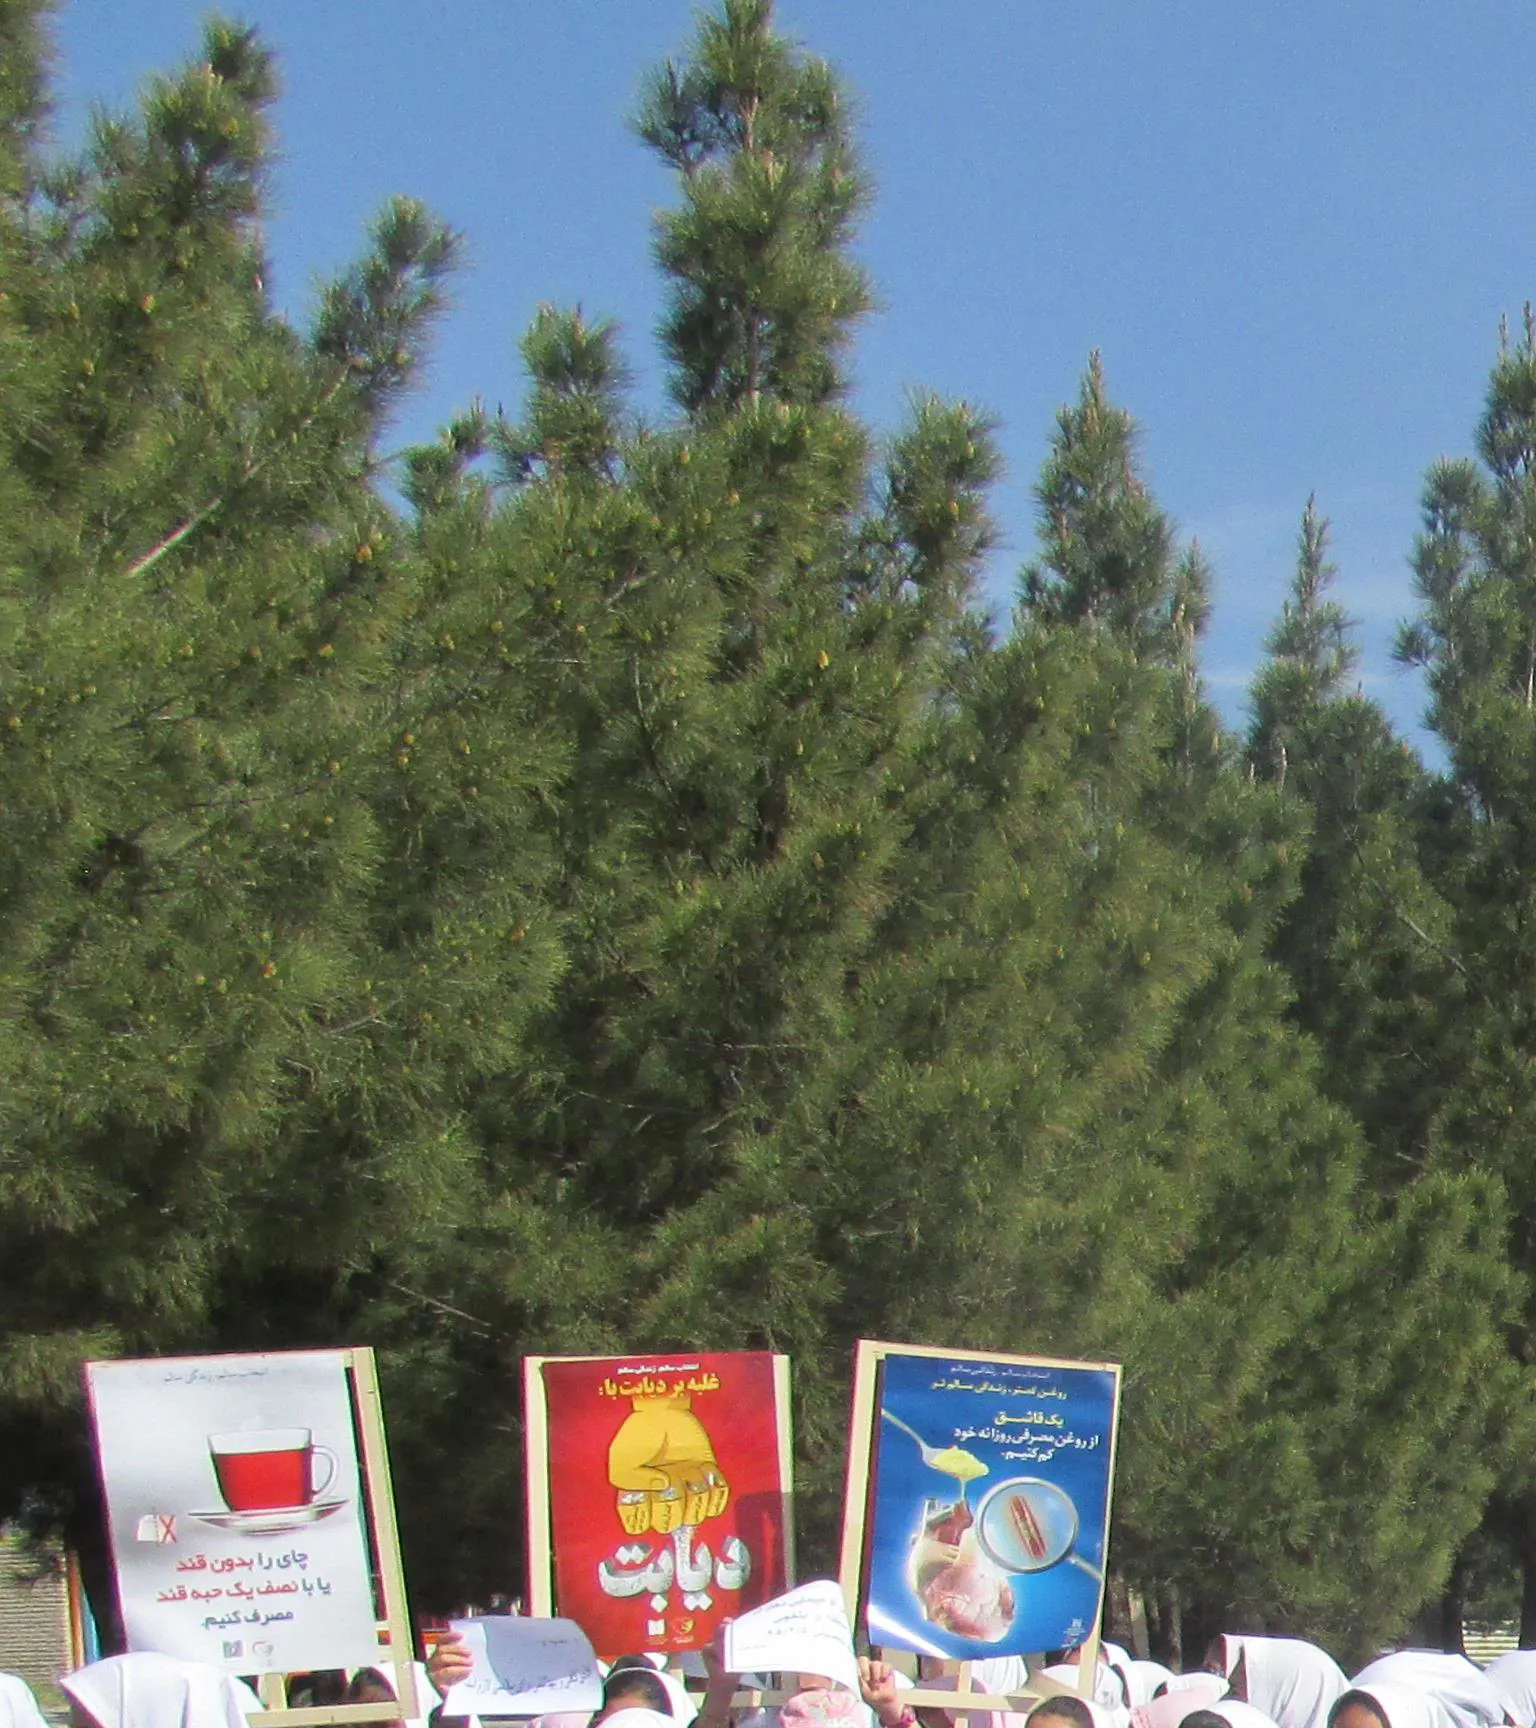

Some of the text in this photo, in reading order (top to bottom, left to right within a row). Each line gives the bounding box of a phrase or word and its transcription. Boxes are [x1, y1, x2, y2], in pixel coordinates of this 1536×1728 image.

[619, 1375, 667, 1398] دیابت
[669, 1380, 685, 1398] بر
[686, 1373, 720, 1396] غلبه
[994, 1410, 1065, 1428] یک قاشق
[954, 1425, 1100, 1450] از روغن مصرفی روزانه خود
[1037, 1448, 1056, 1462] کم
[176, 1549, 309, 1574] چای را بدون قند
[598, 1524, 751, 1613] دیابت
[156, 1577, 331, 1603] یا با نصف یک حبه قند
[244, 1608, 294, 1627] مصرف
